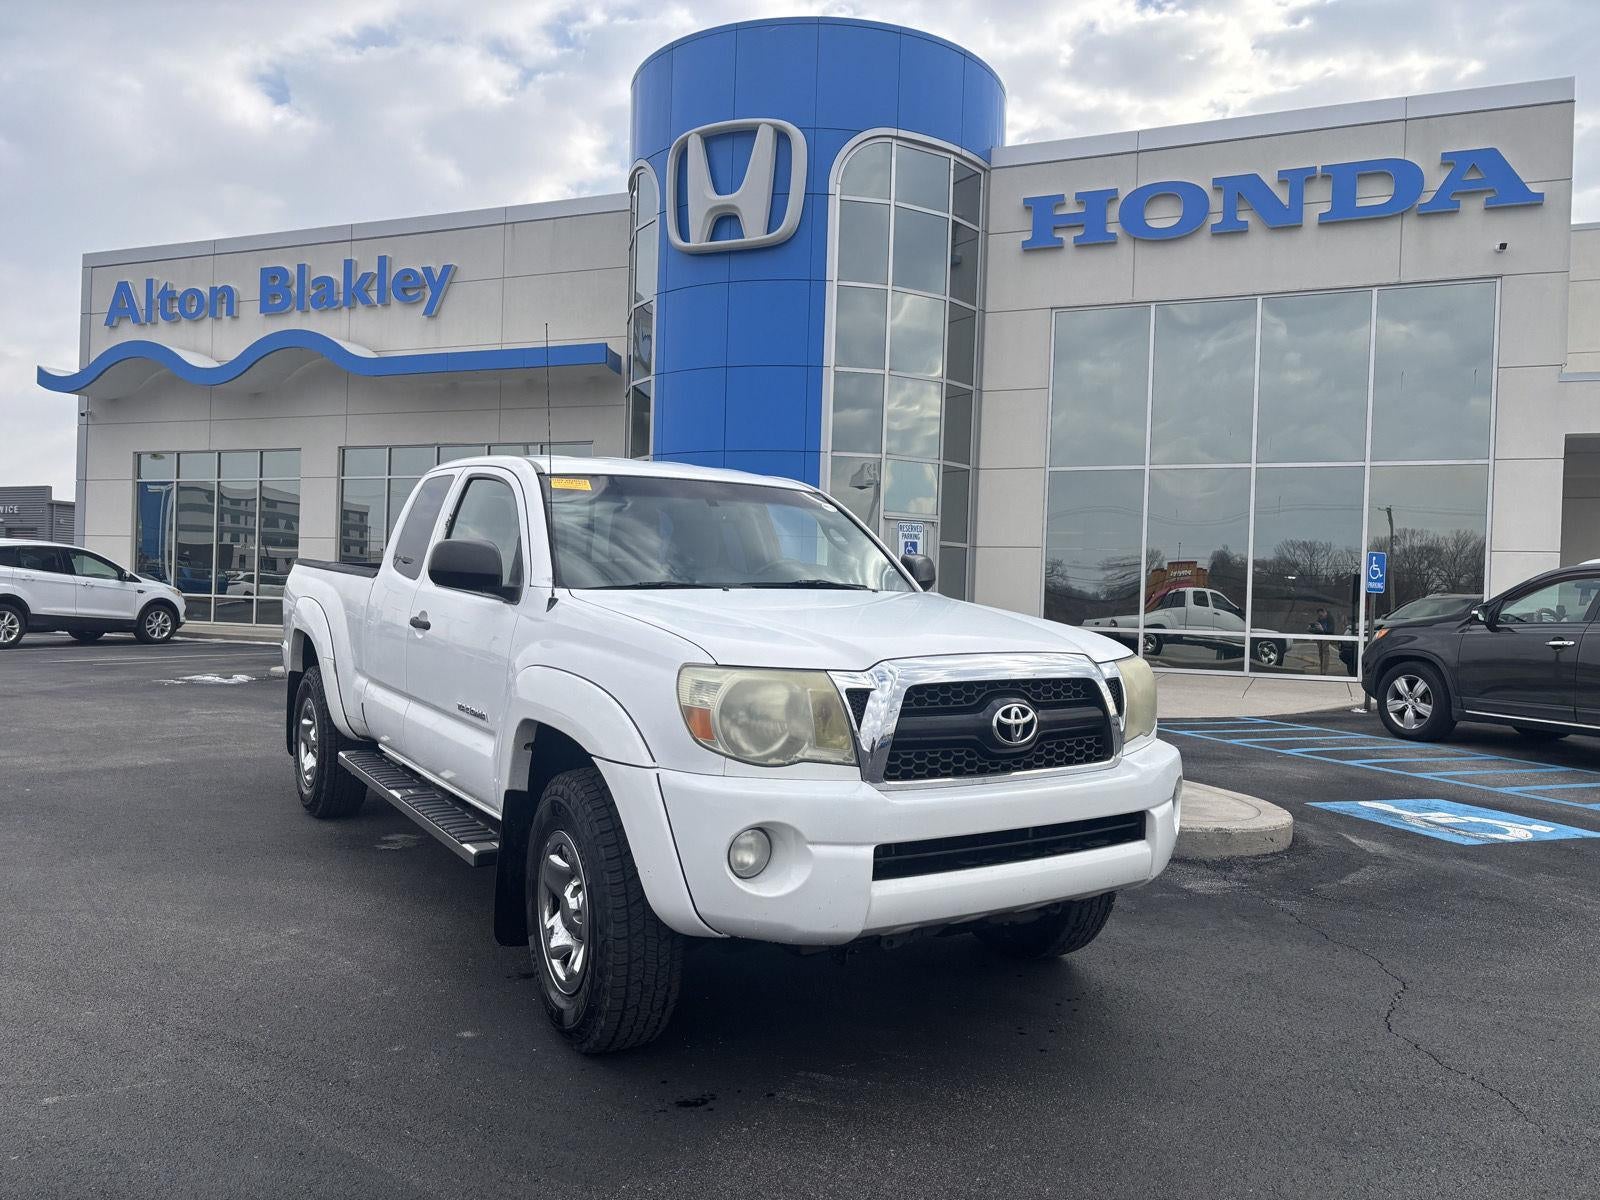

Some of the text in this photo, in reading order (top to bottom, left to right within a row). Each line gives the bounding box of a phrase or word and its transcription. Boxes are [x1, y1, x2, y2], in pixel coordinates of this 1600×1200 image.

[1021, 147, 1545, 251] HONDA
[104, 254, 457, 328] Alton Blakley
[900, 524, 922, 533] RESERVED
[901, 532, 921, 541] PARKING
